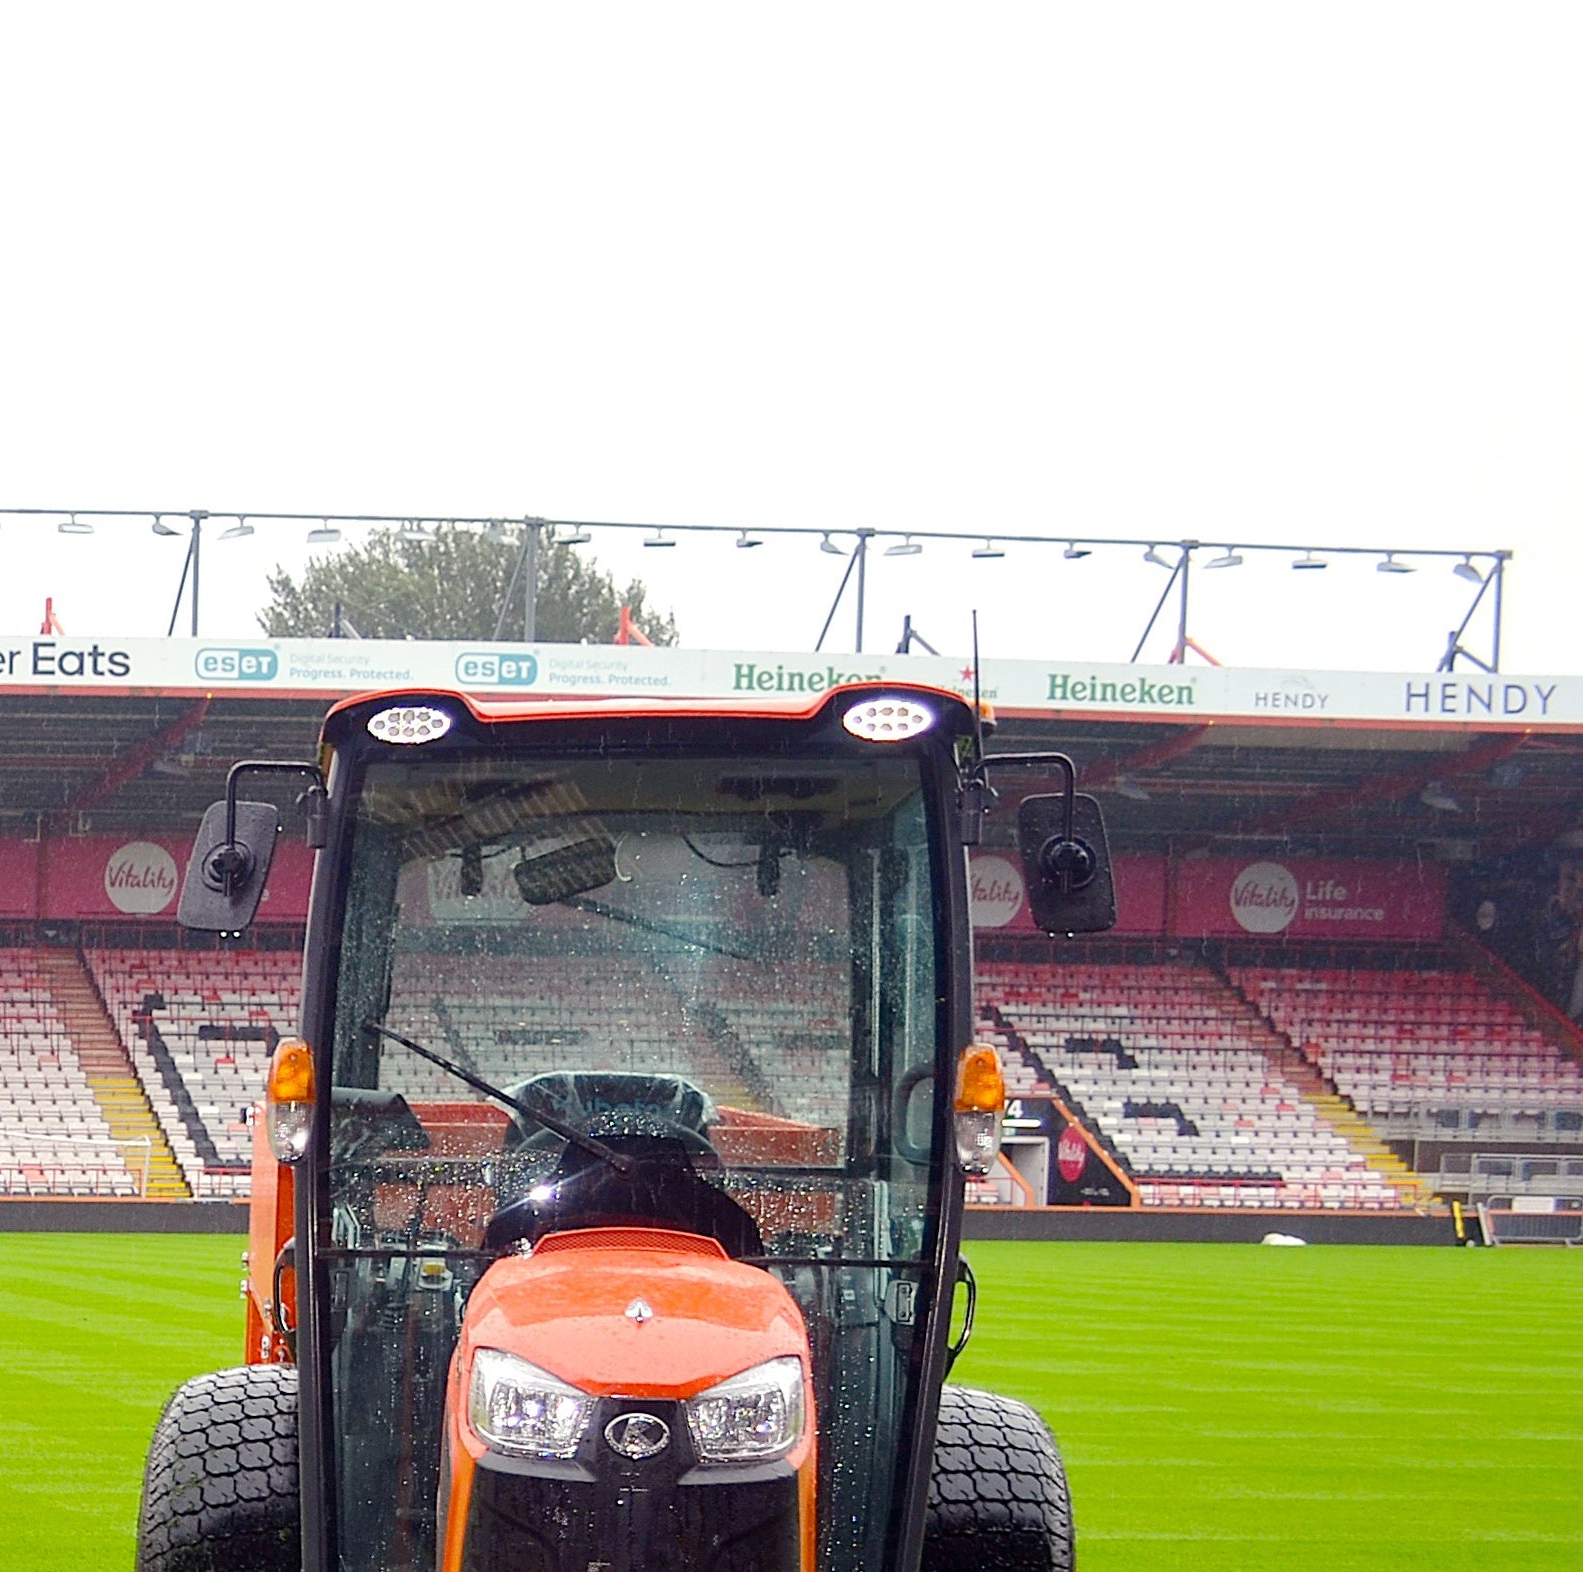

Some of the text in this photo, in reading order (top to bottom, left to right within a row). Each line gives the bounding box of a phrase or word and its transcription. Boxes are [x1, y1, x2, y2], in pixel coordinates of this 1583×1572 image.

[32, 641, 131, 677] Eats
[289, 666, 415, 681] Progress. Protected.
[548, 673, 672, 687] Progress. Protected.
[1046, 673, 1195, 706] Heineken
[1254, 691, 1330, 709] HENDY
[1404, 681, 1557, 715] HENDY
[108, 858, 175, 897] Vitality
[971, 873, 1020, 911] tality
[1234, 878, 1348, 915] Vitality Life
[1305, 905, 1385, 921] insurance
